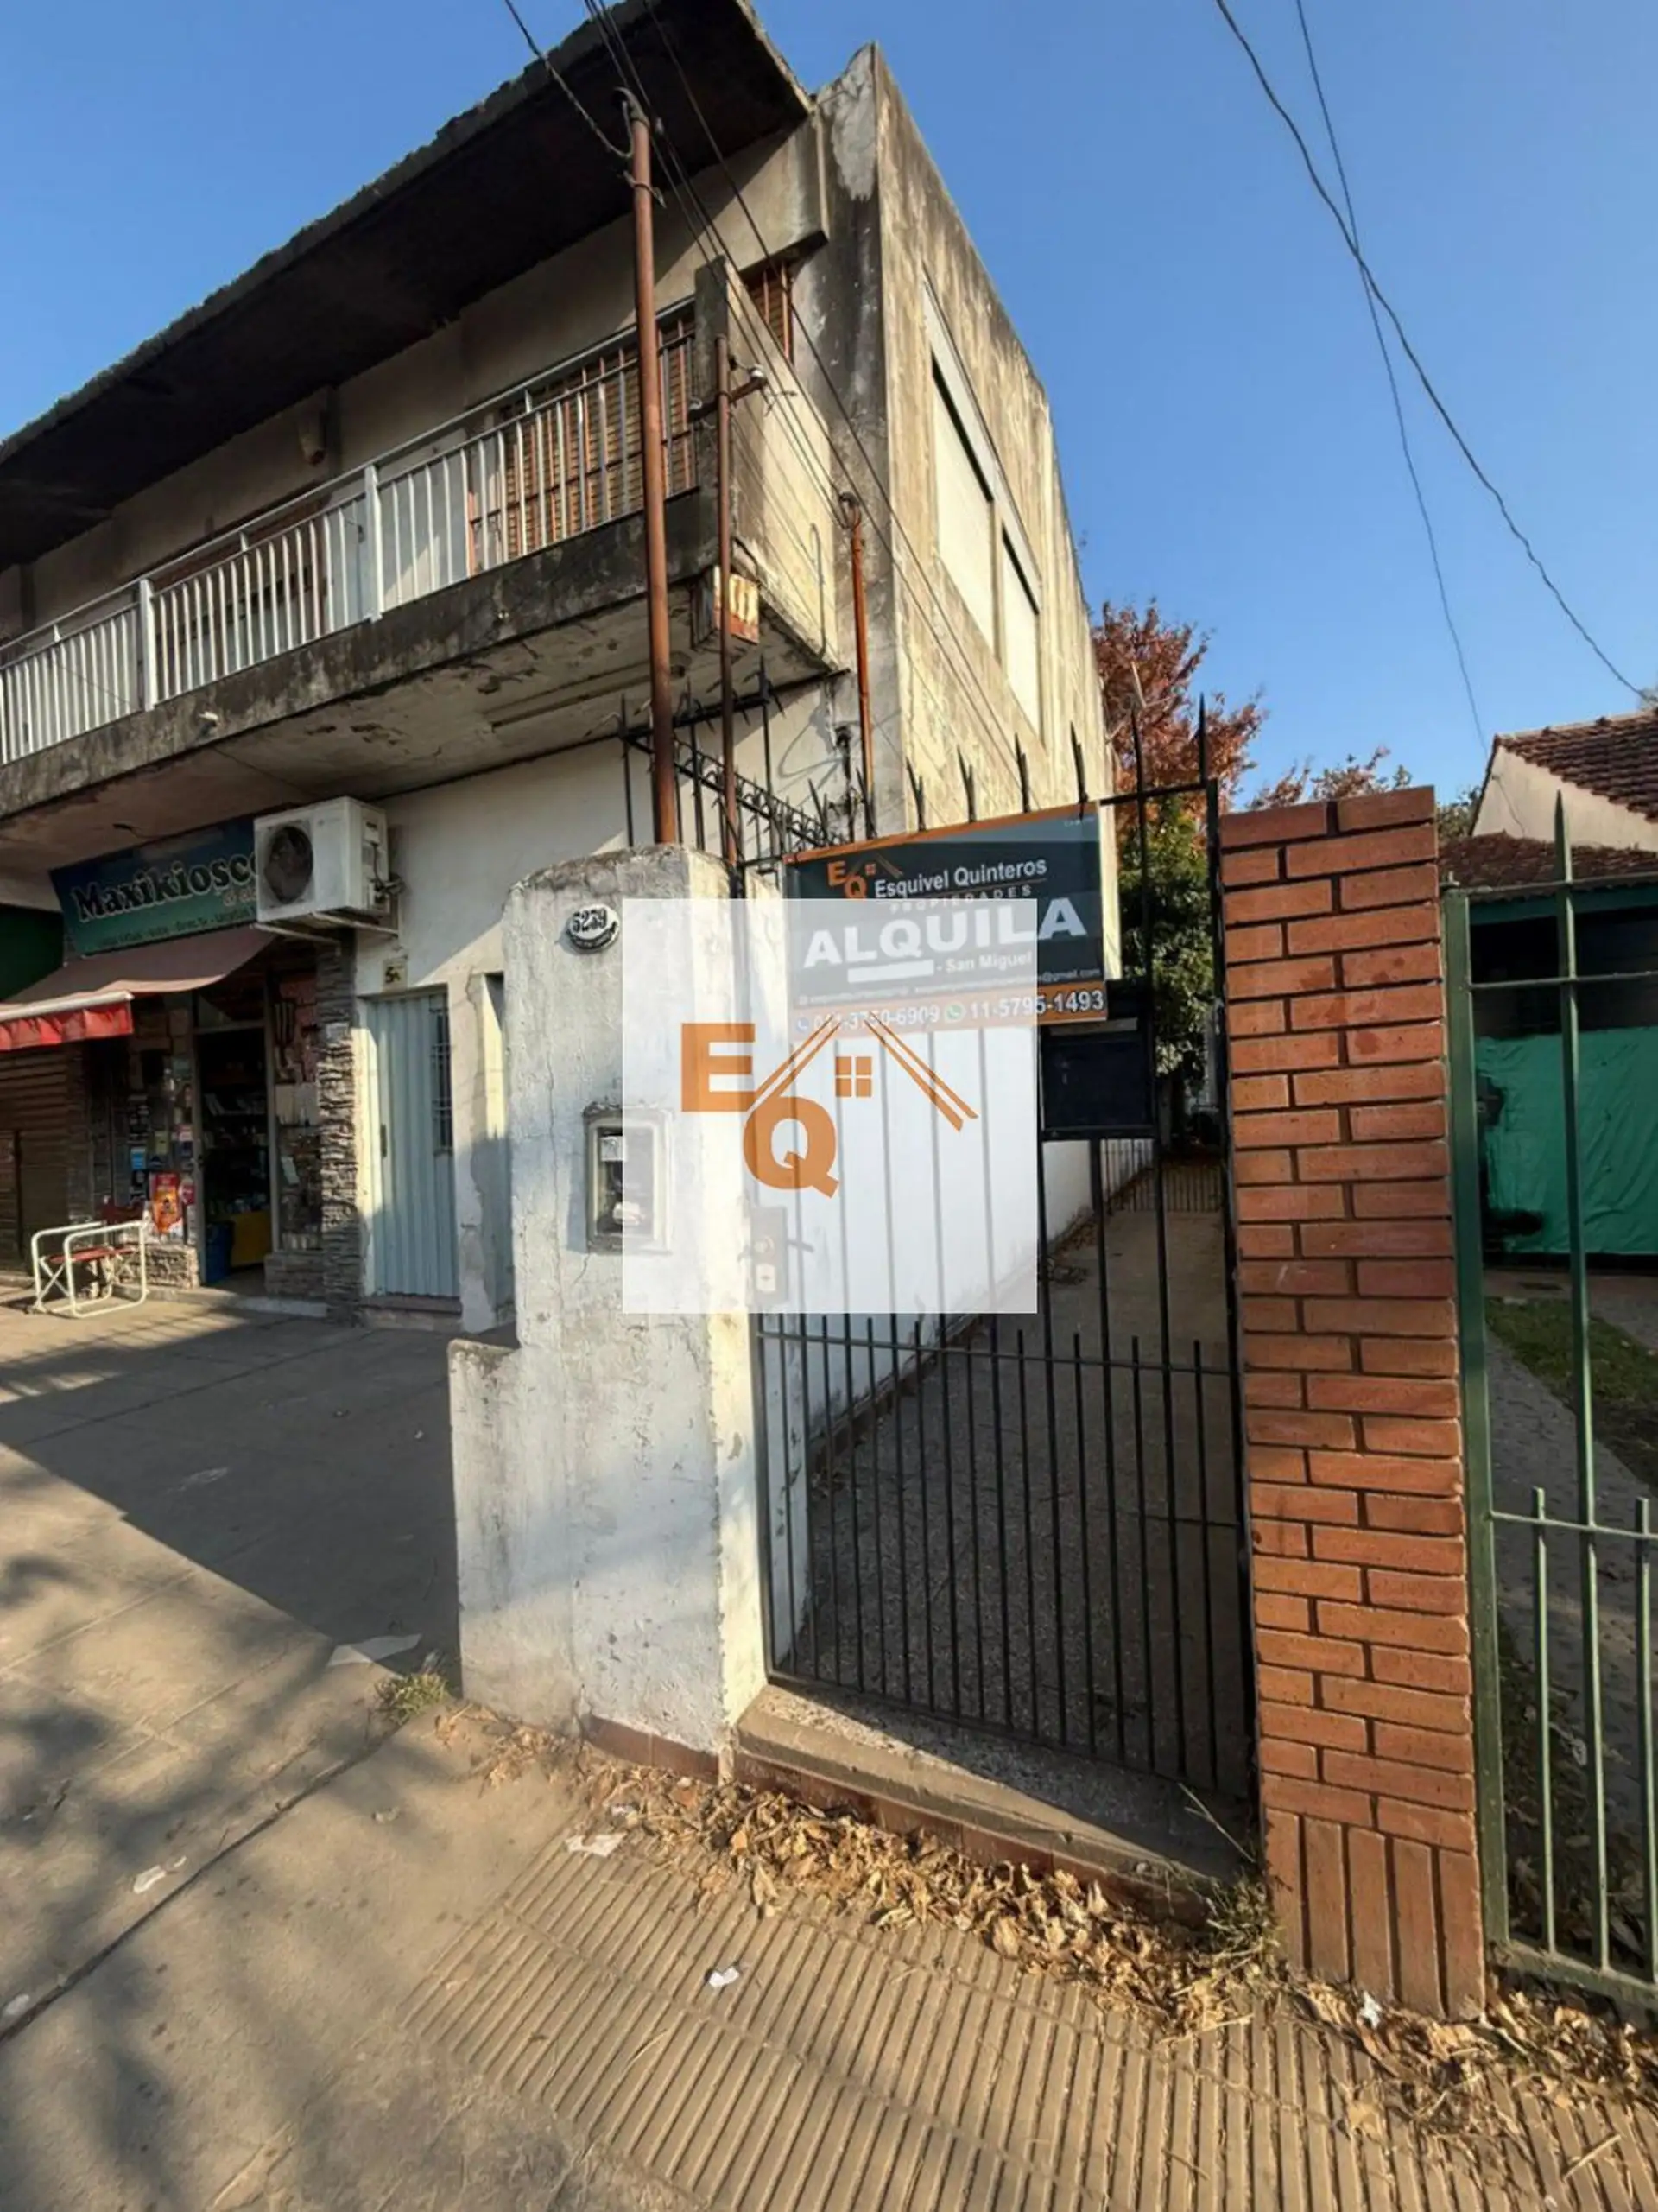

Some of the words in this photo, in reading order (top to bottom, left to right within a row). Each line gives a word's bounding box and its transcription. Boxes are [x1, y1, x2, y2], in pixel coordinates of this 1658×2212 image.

[71, 853, 256, 922] Maxikiosc
[874, 870, 949, 899] Esquivel
[954, 859, 1047, 887] Quinteros
[804, 898, 1088, 968] ALQUILA
[946, 959, 975, 973] San
[979, 952, 1033, 971] Miguel
[970, 990, 1104, 1020] 11-5795-1493
